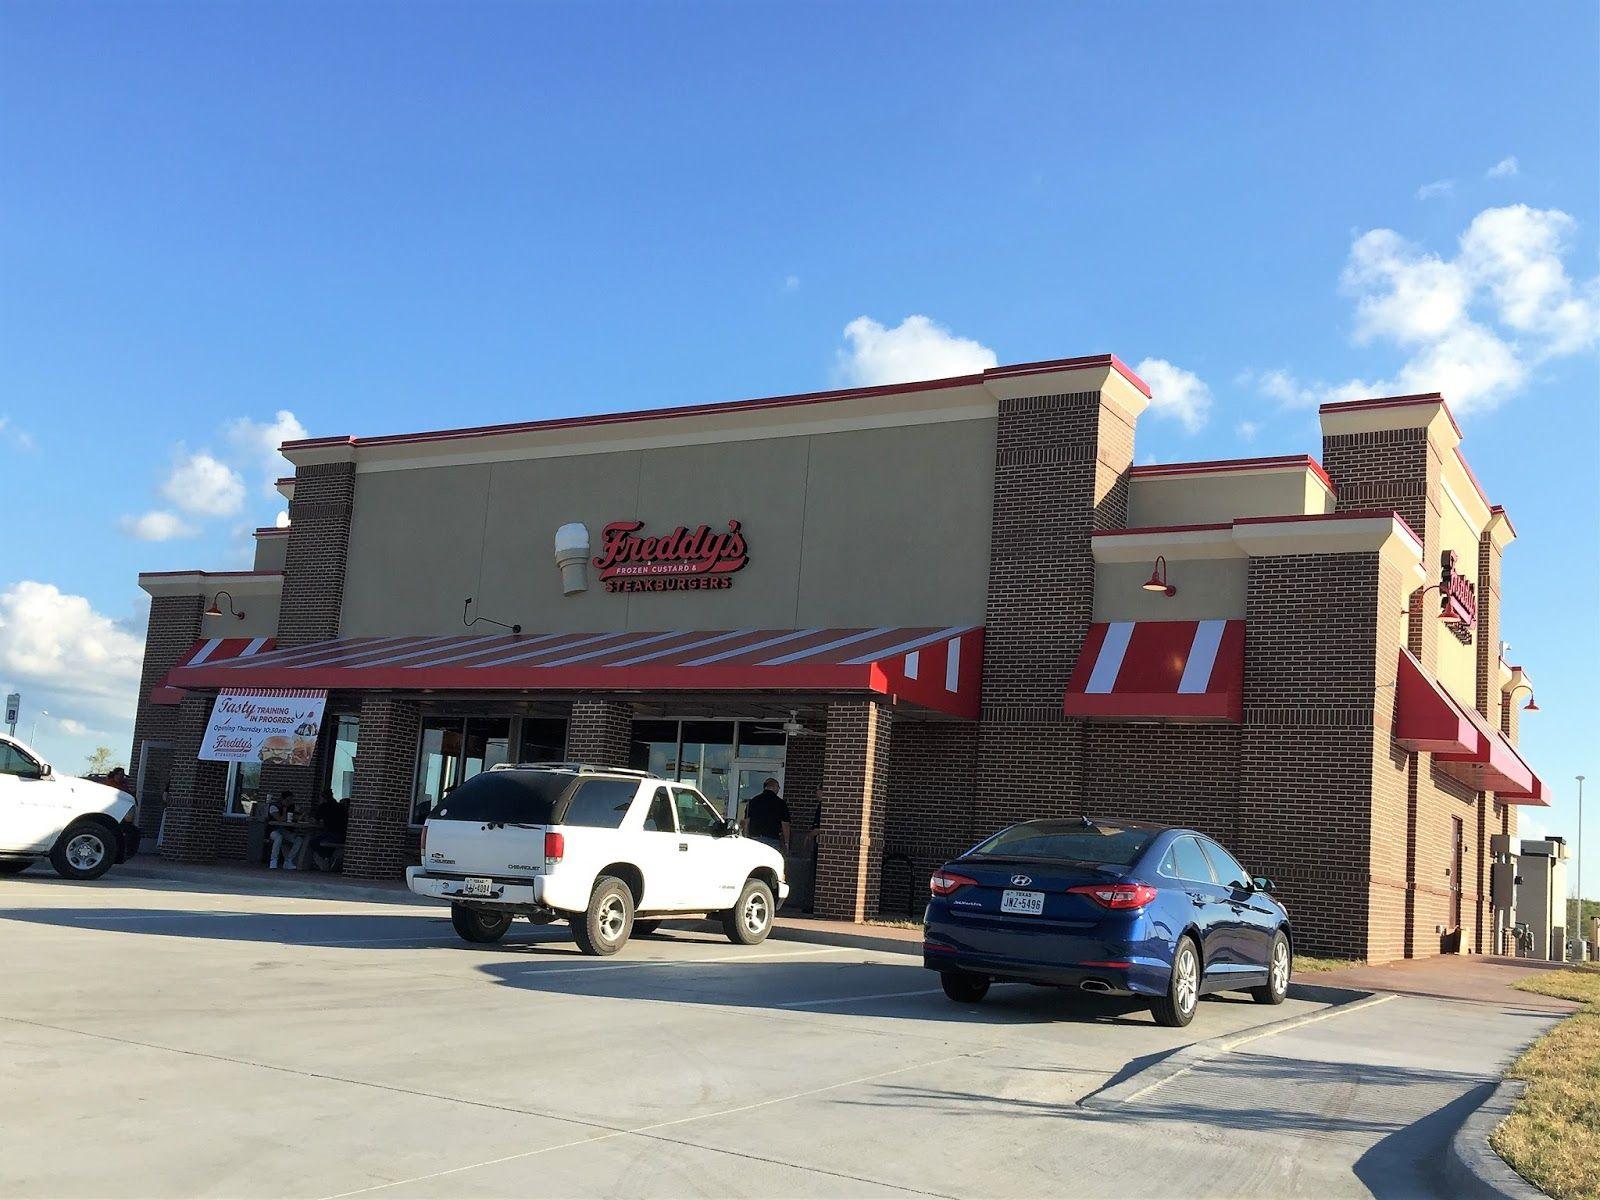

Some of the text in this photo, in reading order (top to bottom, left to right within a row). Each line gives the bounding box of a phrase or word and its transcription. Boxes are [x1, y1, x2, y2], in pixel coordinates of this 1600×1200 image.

[592, 519, 749, 577] Freddy's
[616, 566, 649, 575] FROZEN
[652, 564, 690, 573] CUSTARD
[605, 576, 732, 593] STEAKBURGERS
[218, 697, 290, 718] Tasty TRAINING
[258, 715, 295, 724] PROGRESS
[213, 724, 235, 733] Opening
[236, 725, 262, 733] Thursday
[212, 735, 253, 752] Freddy's
